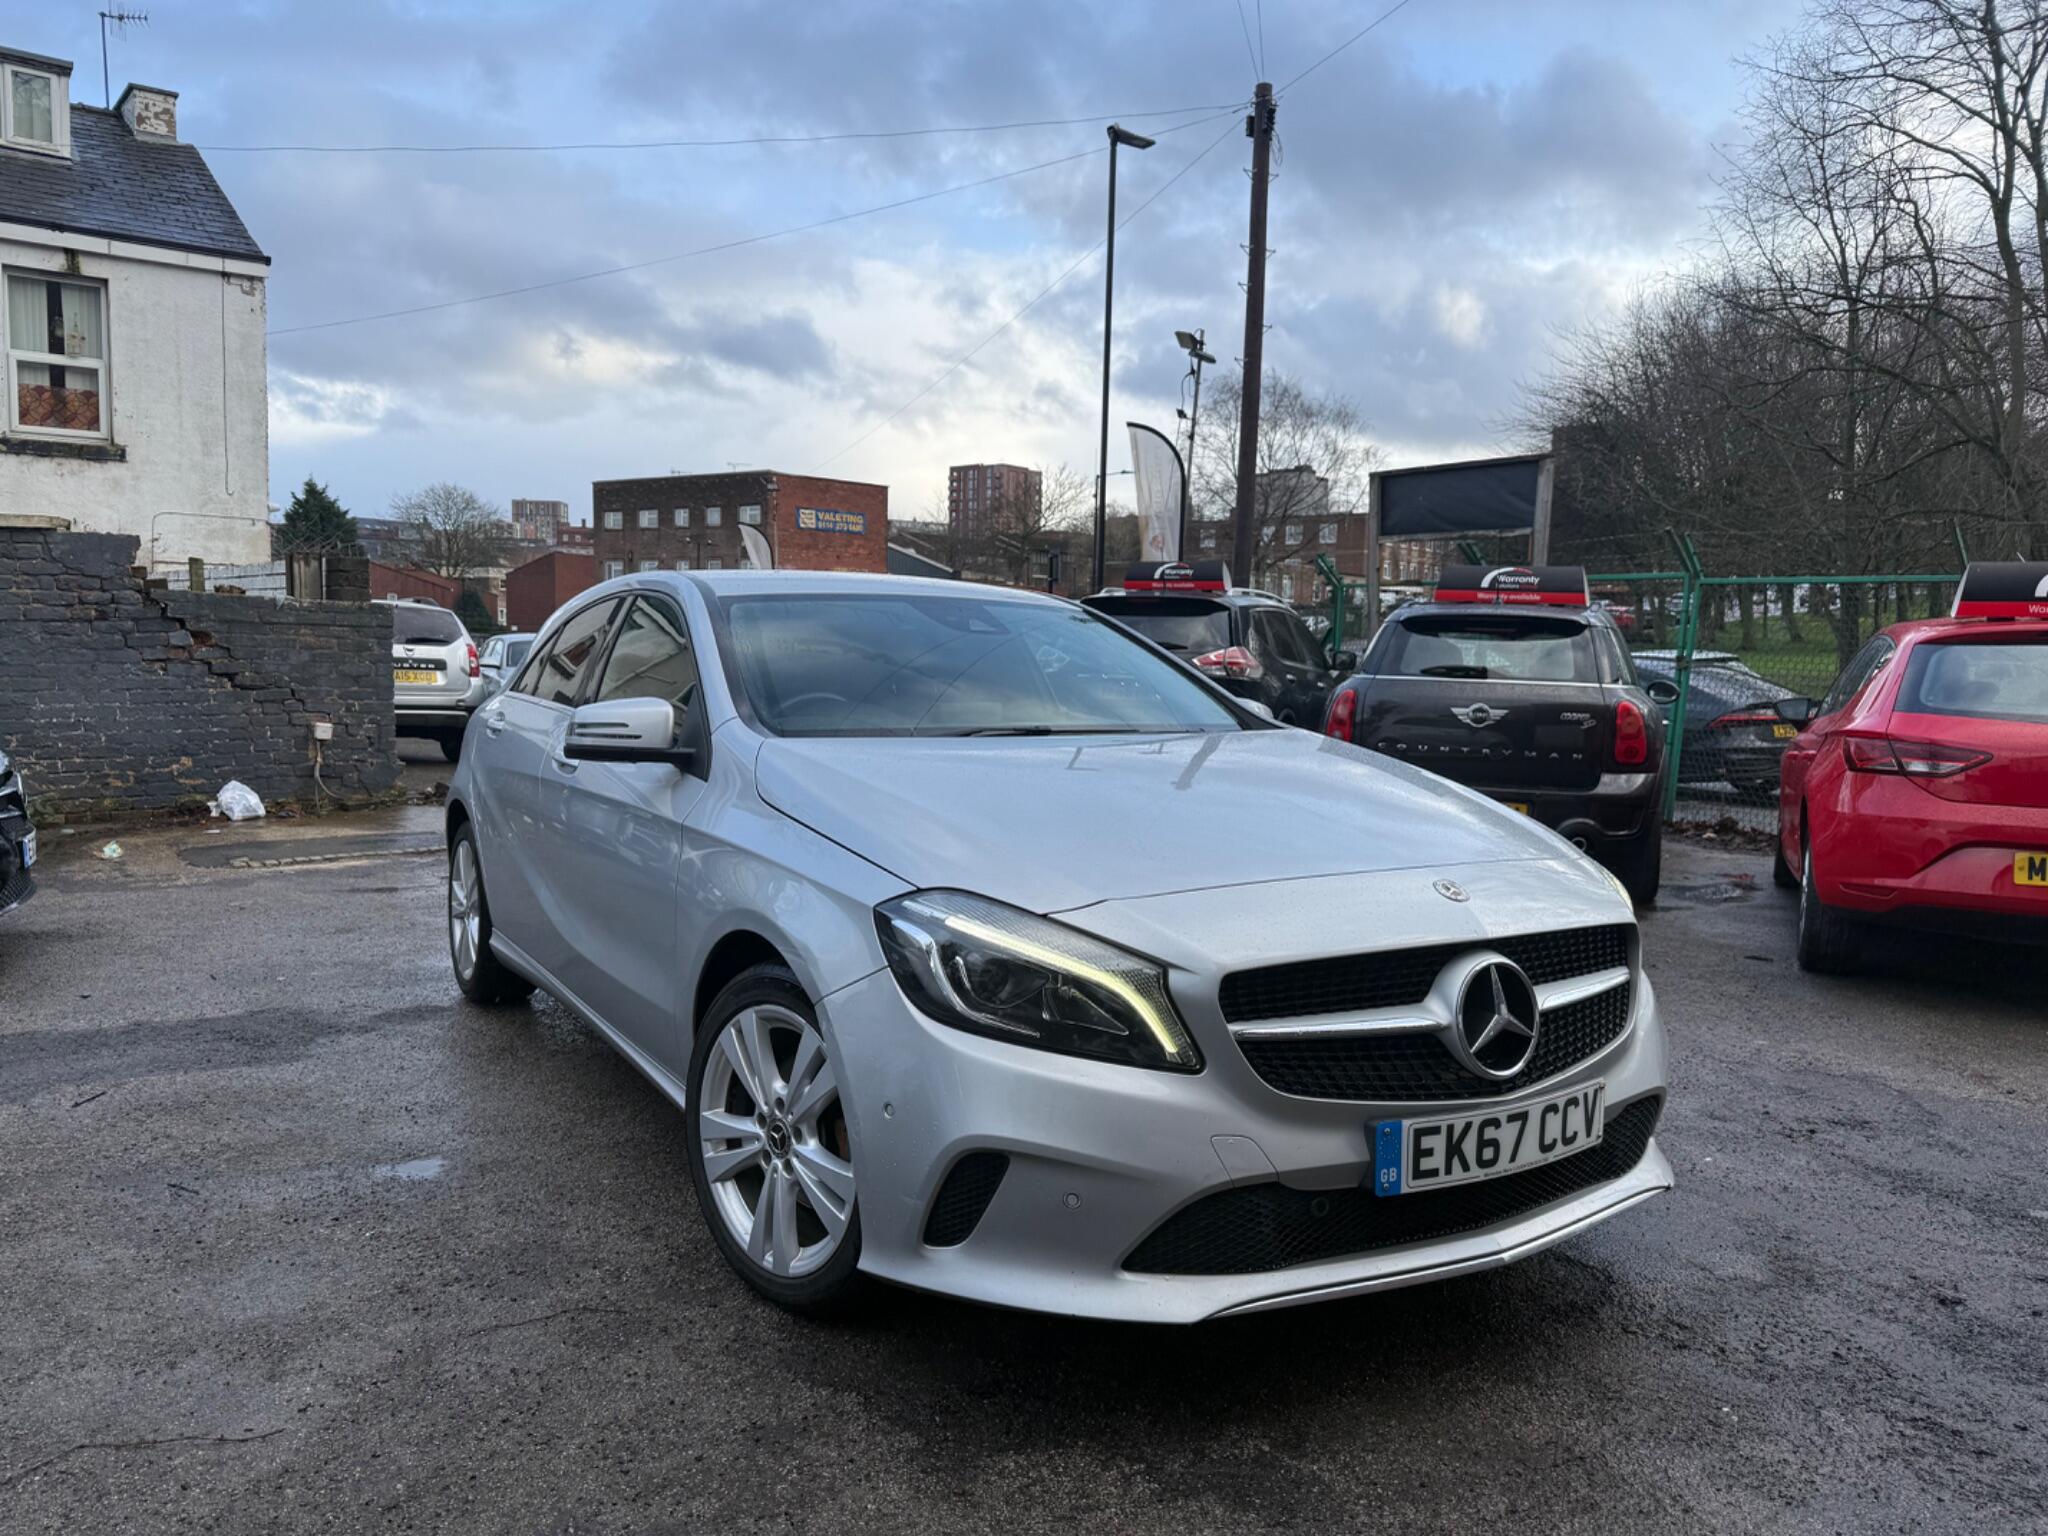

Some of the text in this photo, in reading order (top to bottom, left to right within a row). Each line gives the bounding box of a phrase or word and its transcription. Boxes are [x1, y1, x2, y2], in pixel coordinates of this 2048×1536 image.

[817, 511, 864, 523] VALETING
[1497, 575, 1540, 585] Warranty
[1411, 1088, 1600, 1181] EK67 CCV
[1380, 1167, 1398, 1183] GB
